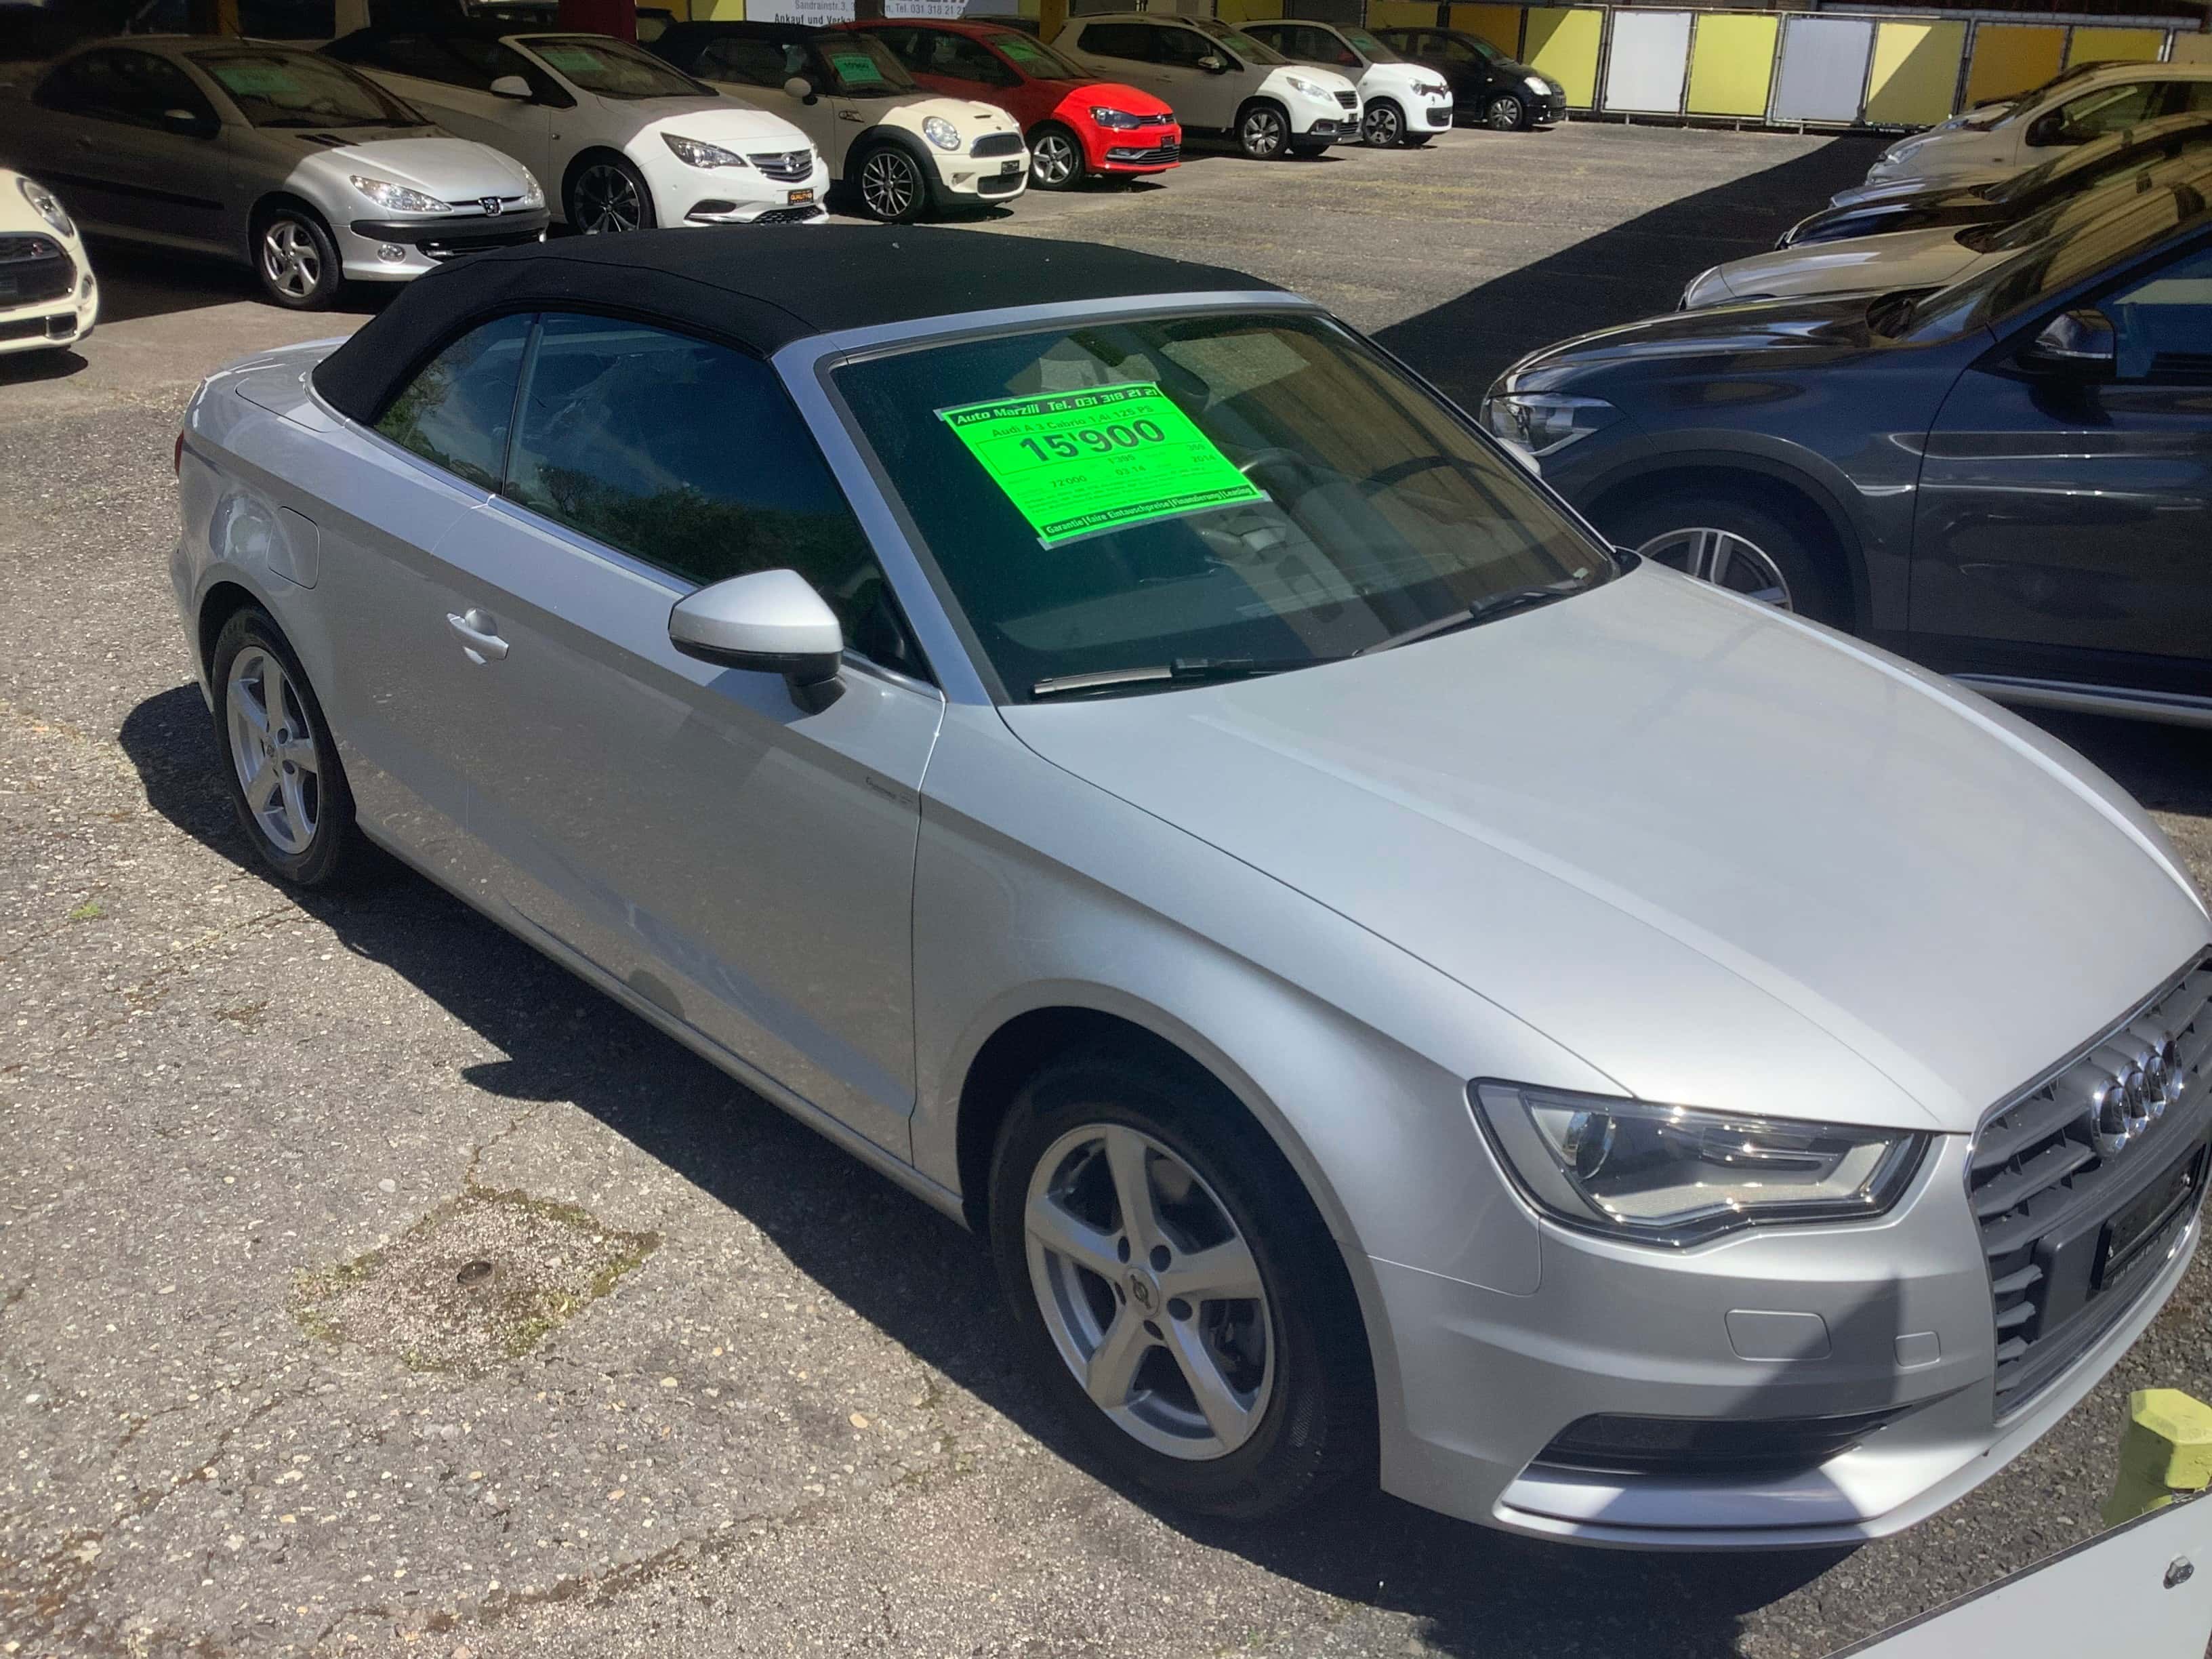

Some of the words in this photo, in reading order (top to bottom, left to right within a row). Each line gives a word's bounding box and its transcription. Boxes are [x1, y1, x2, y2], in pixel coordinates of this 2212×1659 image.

[775, 13, 804, 24] Ankauf
[807, 15, 824, 24] und
[910, 4, 924, 13] 031
[927, 4, 942, 14] 318
[945, 5, 954, 14] 21
[957, 411, 991, 424] Auto
[993, 404, 1040, 417] Marzili
[1048, 400, 1072, 411] Tel.
[1075, 397, 1099, 407] 031
[1101, 392, 1124, 403] 318
[1126, 389, 1142, 398] 21
[991, 424, 1020, 437] Audi
[1024, 424, 1034, 432] A
[1036, 423, 1044, 431] 3
[1046, 417, 1086, 430] Cabrio
[1113, 408, 1136, 417] 125
[1137, 405, 1154, 414] PS
[1019, 419, 1166, 462] 15'900
